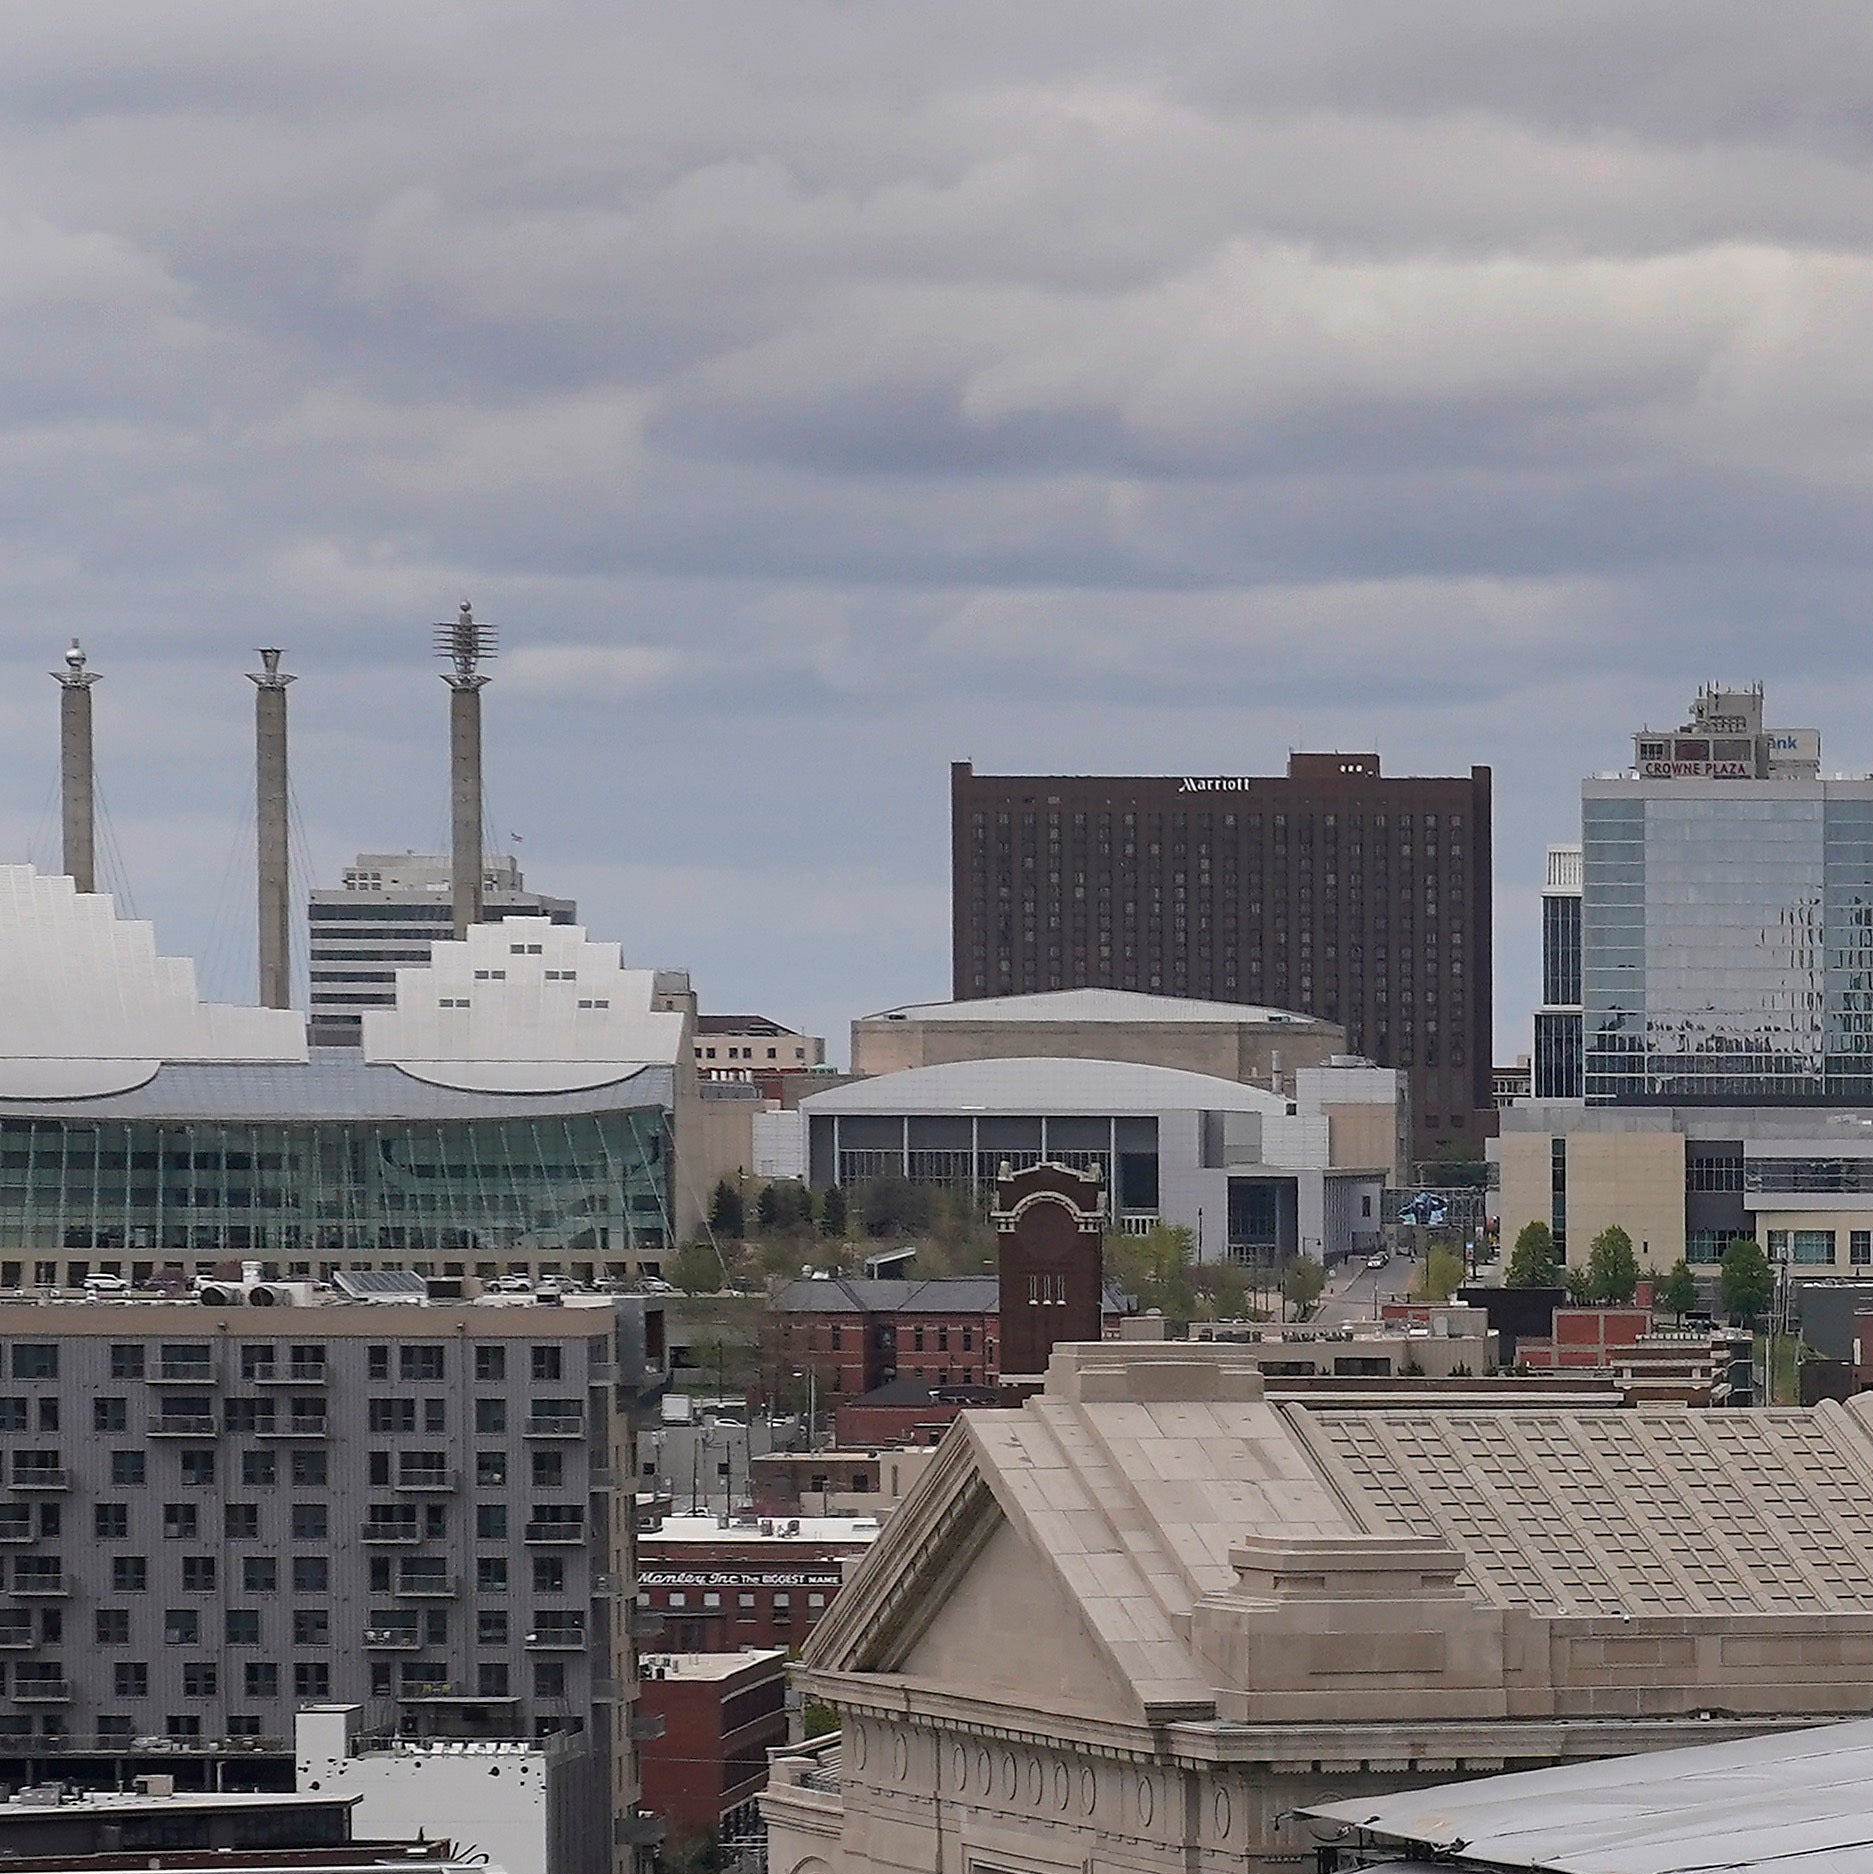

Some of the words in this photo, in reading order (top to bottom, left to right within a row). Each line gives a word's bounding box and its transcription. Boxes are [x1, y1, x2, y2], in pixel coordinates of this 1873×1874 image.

[1767, 735, 1798, 749] ank
[1645, 762, 1700, 775] CROWNE
[1705, 762, 1746, 775] PLAZA
[1178, 777, 1250, 792] Marriott
[637, 1572, 707, 1585] Manley
[708, 1572, 739, 1584] Inc
[762, 1574, 805, 1584] BIGGEST
[808, 1576, 839, 1584] NAME
